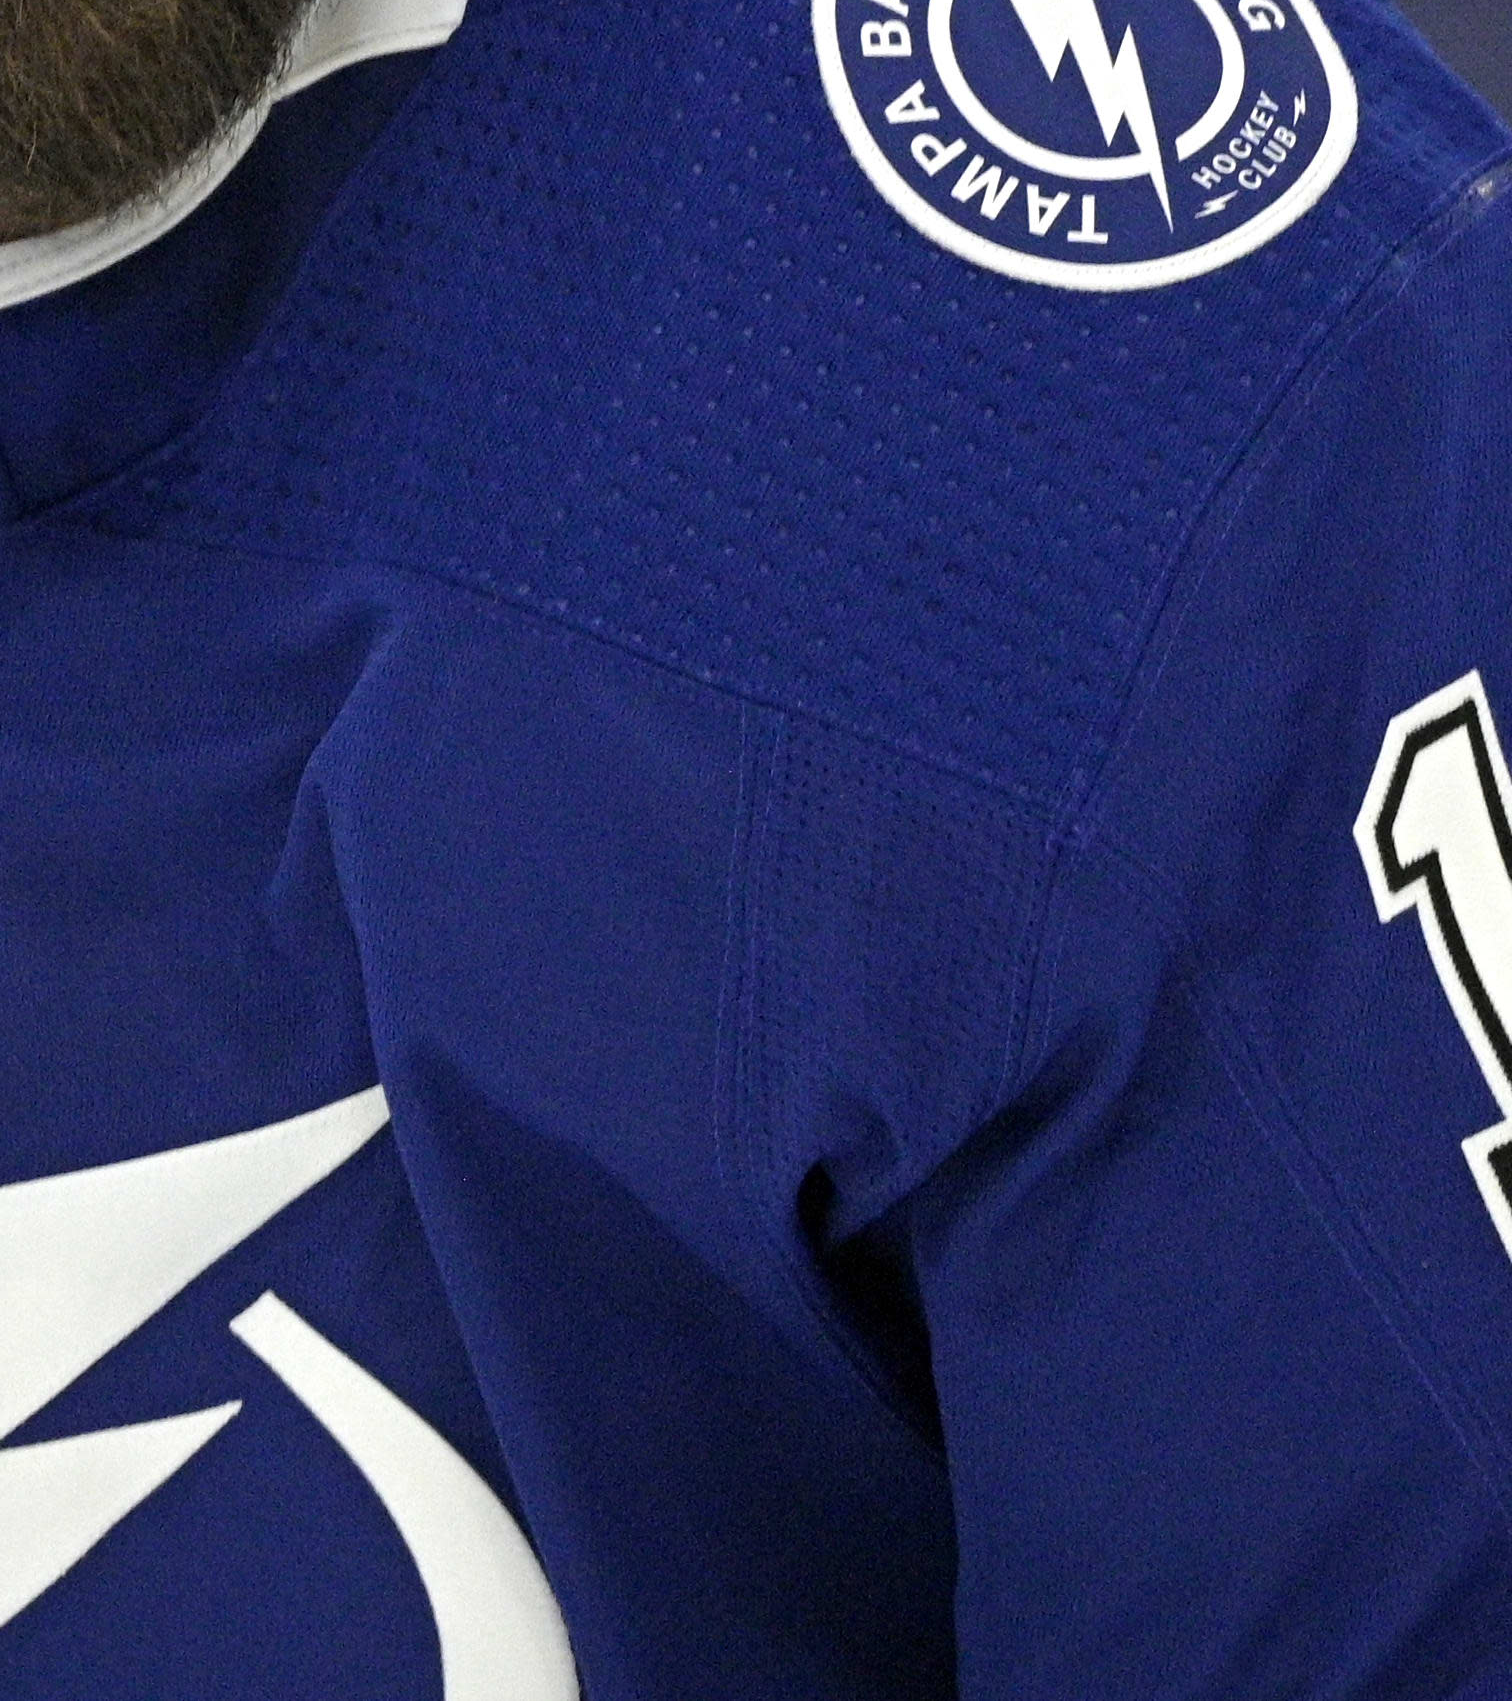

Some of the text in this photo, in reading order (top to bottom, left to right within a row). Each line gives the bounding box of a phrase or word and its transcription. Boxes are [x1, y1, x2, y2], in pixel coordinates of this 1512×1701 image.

[885, 79, 1108, 244] TAMPA
[1191, 89, 1280, 189] HOCKEY
[1238, 127, 1297, 190] CLUB
